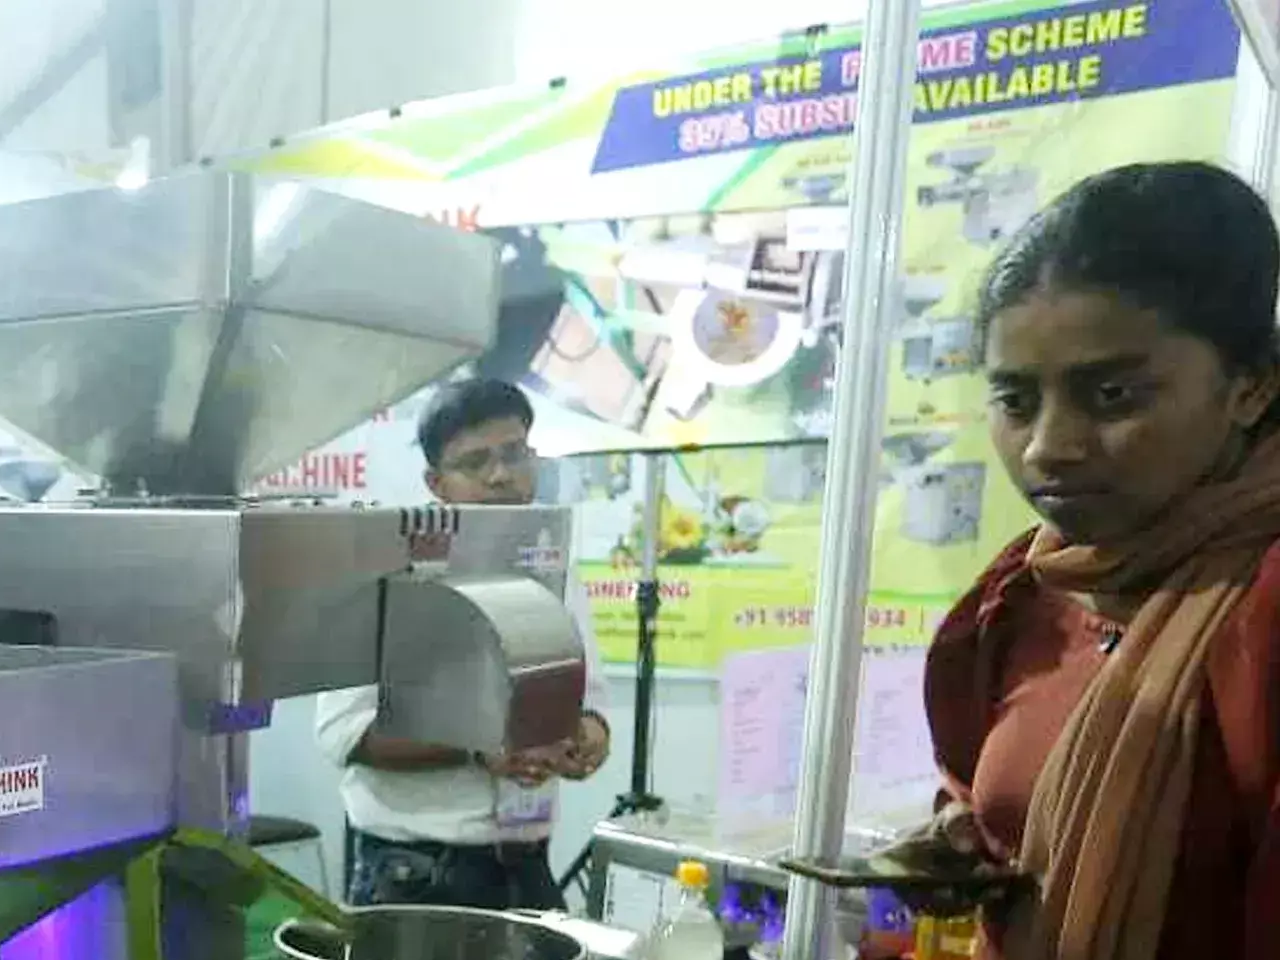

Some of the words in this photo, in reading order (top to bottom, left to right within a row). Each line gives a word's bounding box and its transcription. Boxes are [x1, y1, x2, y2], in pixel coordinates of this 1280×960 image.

[652, 71, 753, 118] UNDER
[760, 61, 822, 95] THE
[986, 6, 1147, 59] SCHEME
[915, 56, 1101, 112] AVAILABLE
